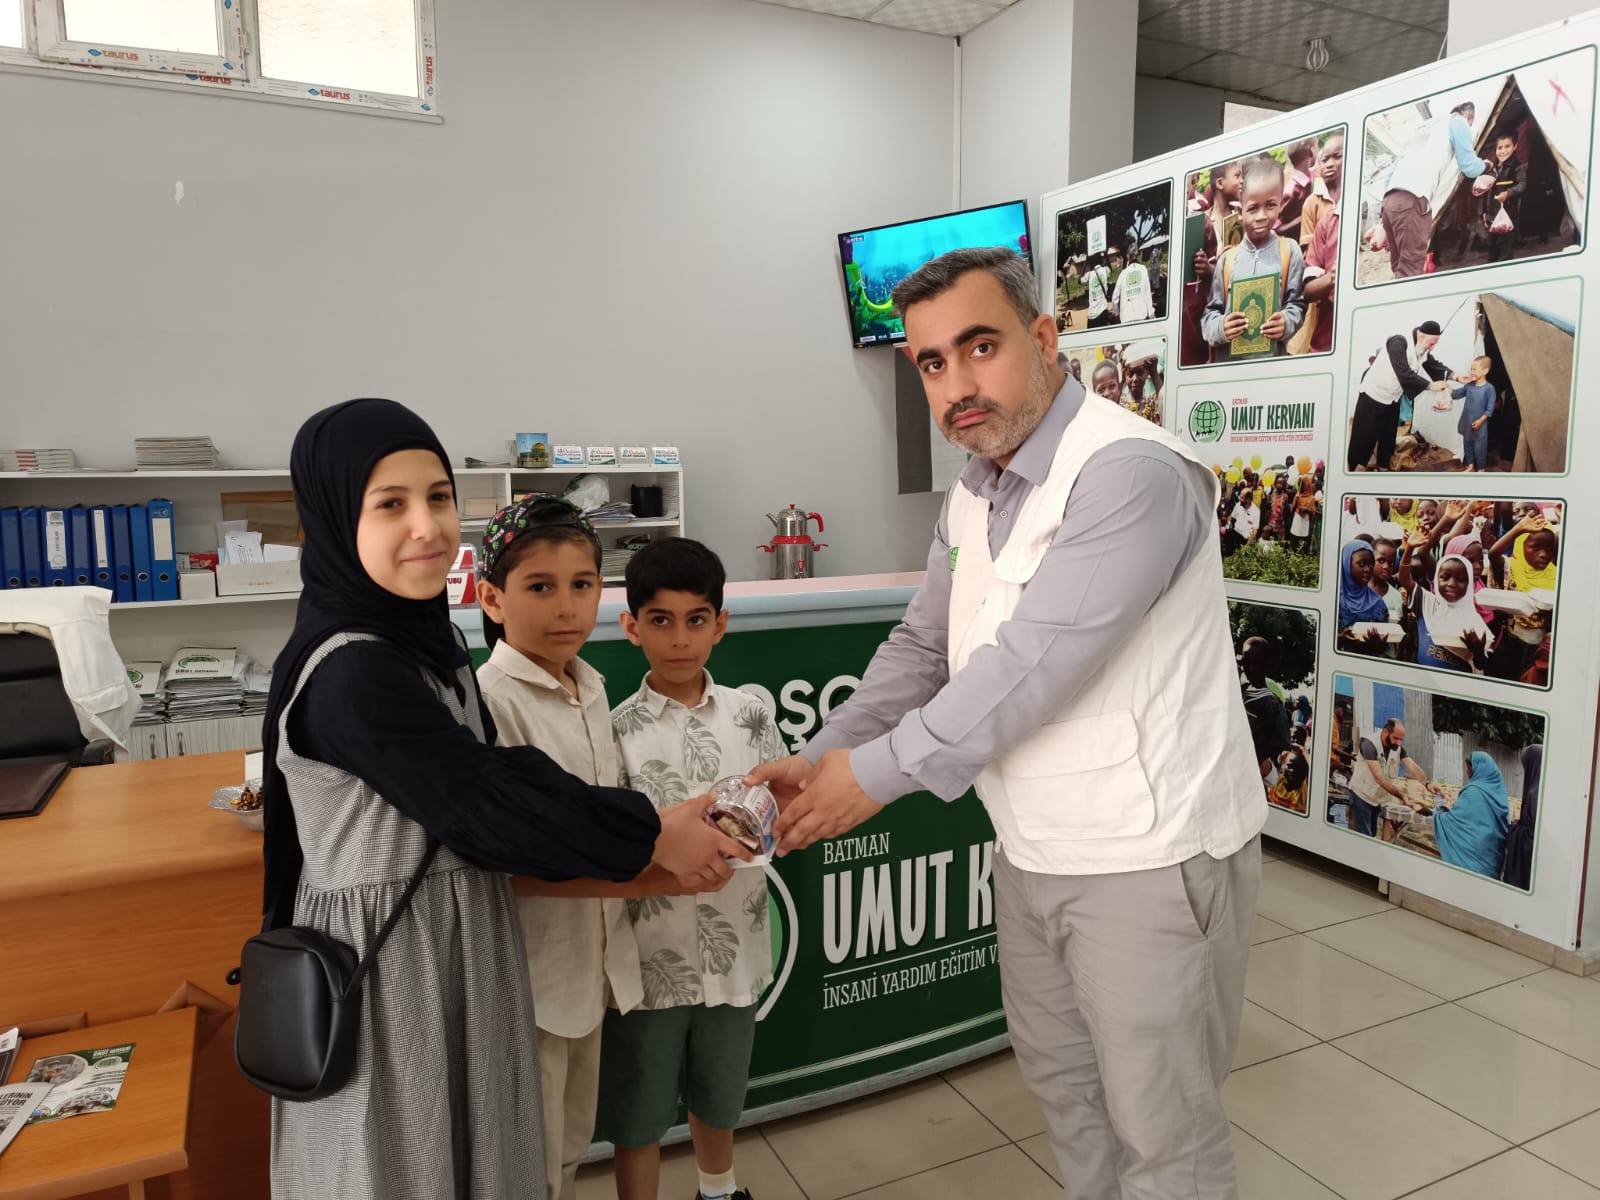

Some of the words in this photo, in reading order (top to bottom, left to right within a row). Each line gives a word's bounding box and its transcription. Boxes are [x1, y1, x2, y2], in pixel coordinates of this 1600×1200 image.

[319, 89, 351, 100] taurus
[1231, 405, 1264, 431] UMUT
[1266, 402, 1315, 430] KERVANI
[823, 832, 891, 865] BATMAN
[823, 850, 954, 964] UMUT
[968, 840, 997, 931] K
[823, 971, 878, 1010] İNSANİ
[881, 961, 936, 996] YARDIM
[940, 945, 986, 980] EĞİTİM
[985, 944, 1000, 964] V
